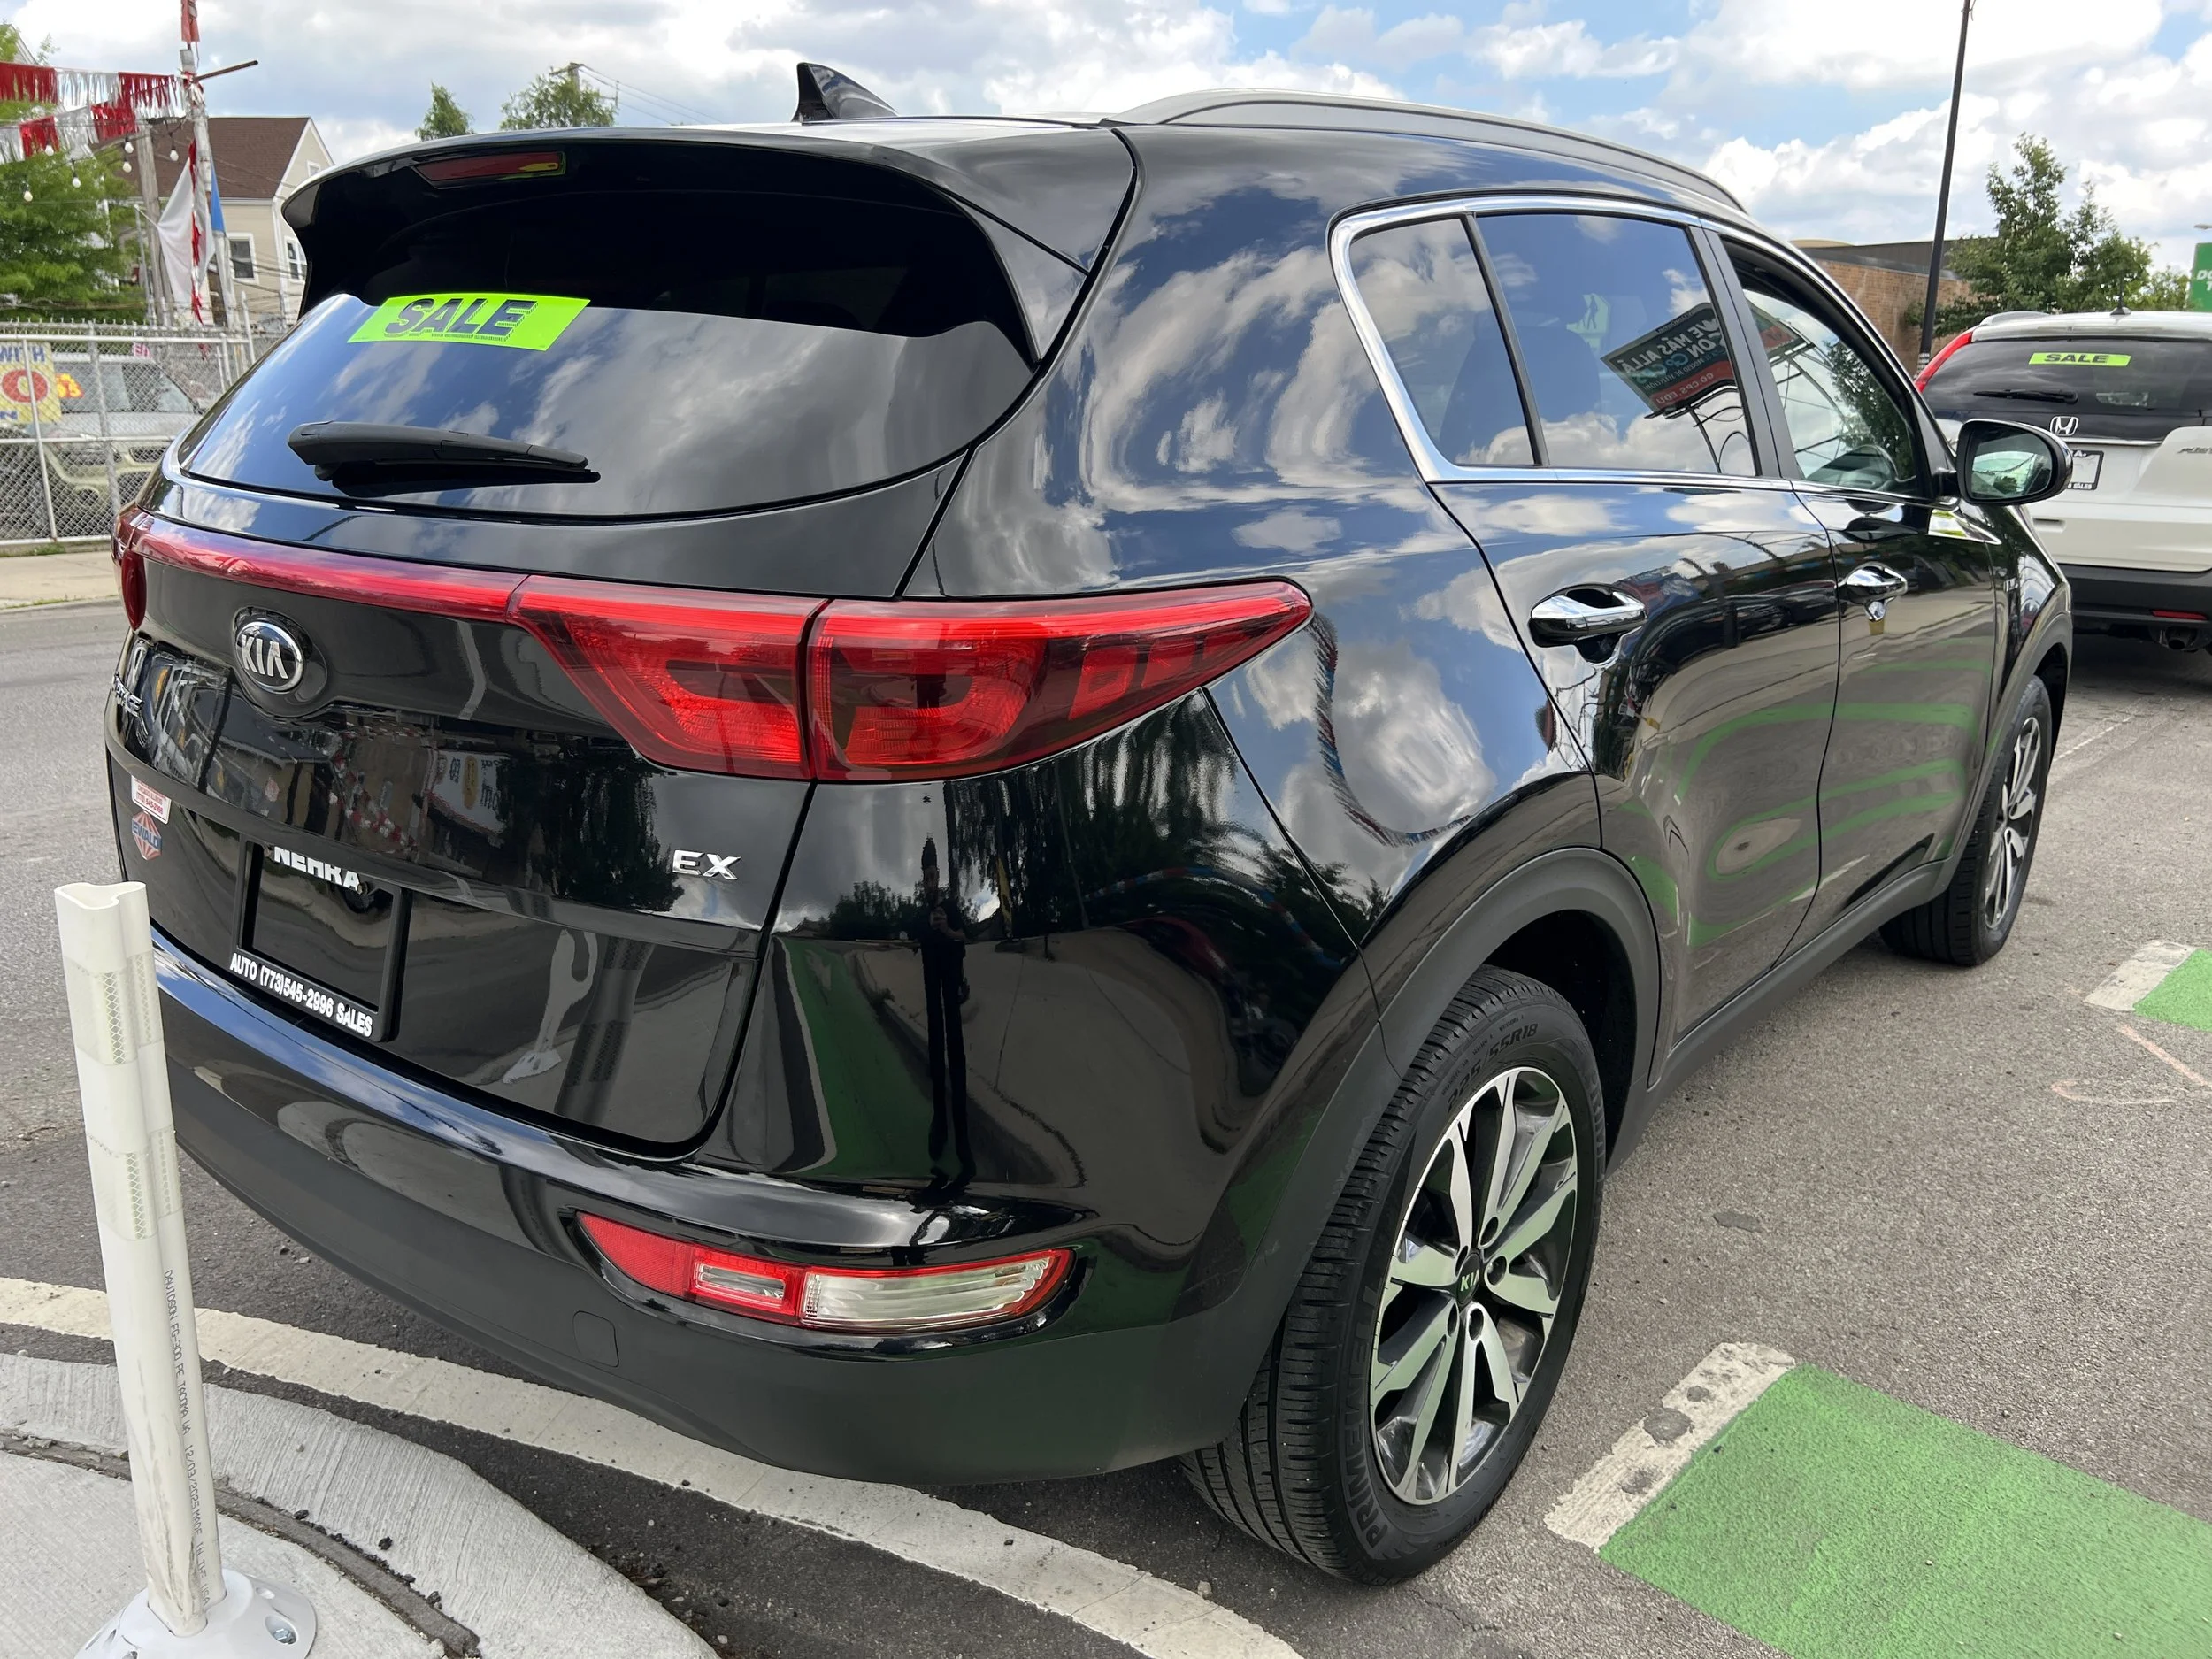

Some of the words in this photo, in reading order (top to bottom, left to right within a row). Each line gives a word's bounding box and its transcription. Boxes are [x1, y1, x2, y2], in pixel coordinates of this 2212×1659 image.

[384, 298, 539, 342] SALE
[0, 346, 45, 362] WIH
[2044, 354, 2109, 364] SALE
[242, 634, 288, 679] KIA
[672, 849, 741, 880] EX
[230, 953, 257, 981] AUTO
[336, 1002, 373, 1037] SALES
[164, 1269, 178, 1321] DAVIDSON
[171, 1323, 182, 1361] FG-300
[175, 1363, 185, 1379] PE
[177, 1380, 189, 1419] TACOMA
[182, 1419, 191, 1435] WA
[196, 1541, 204, 1557] IN
